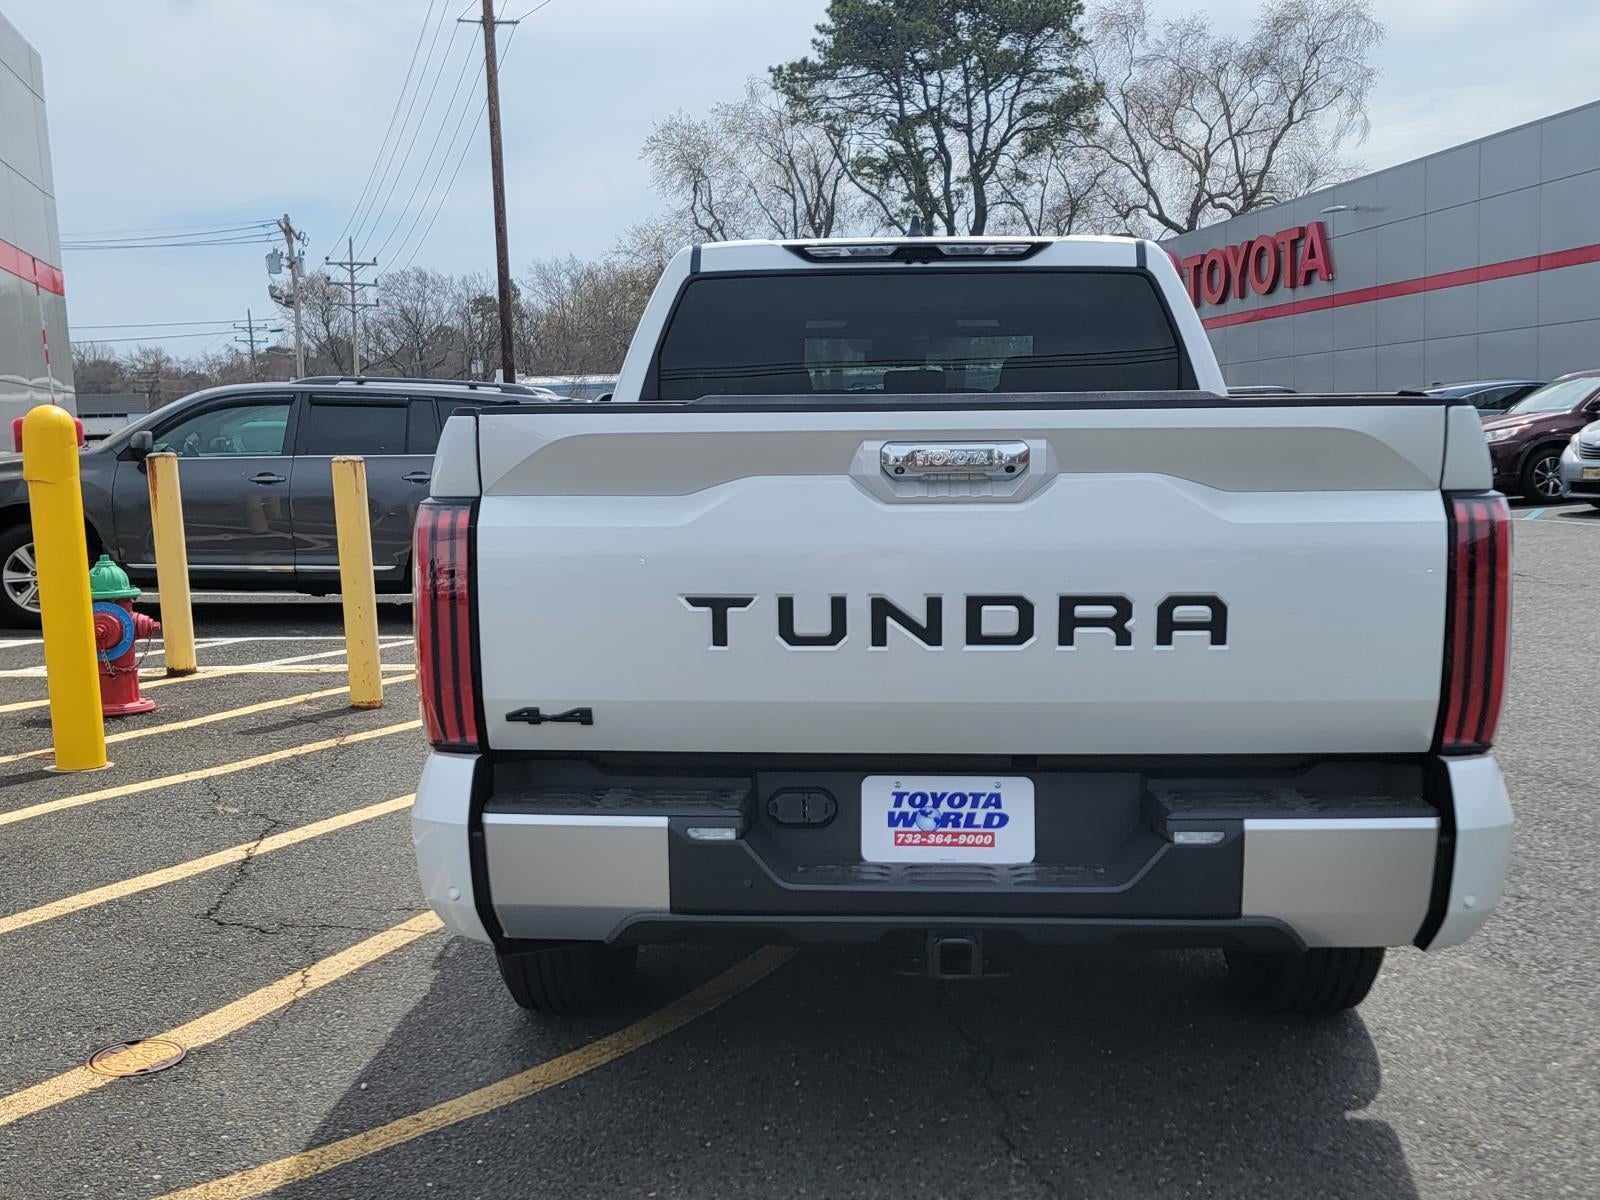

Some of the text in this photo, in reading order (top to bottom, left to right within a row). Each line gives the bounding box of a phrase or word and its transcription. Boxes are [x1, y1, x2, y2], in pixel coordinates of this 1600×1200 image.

[1183, 221, 1333, 309] TOYOTA
[922, 450, 989, 465] TOYOTA
[677, 592, 1230, 650] TUNDRA
[891, 791, 1003, 809] TOYOTA
[888, 809, 1010, 831] WORLD
[896, 833, 993, 845] 732-364-9000
